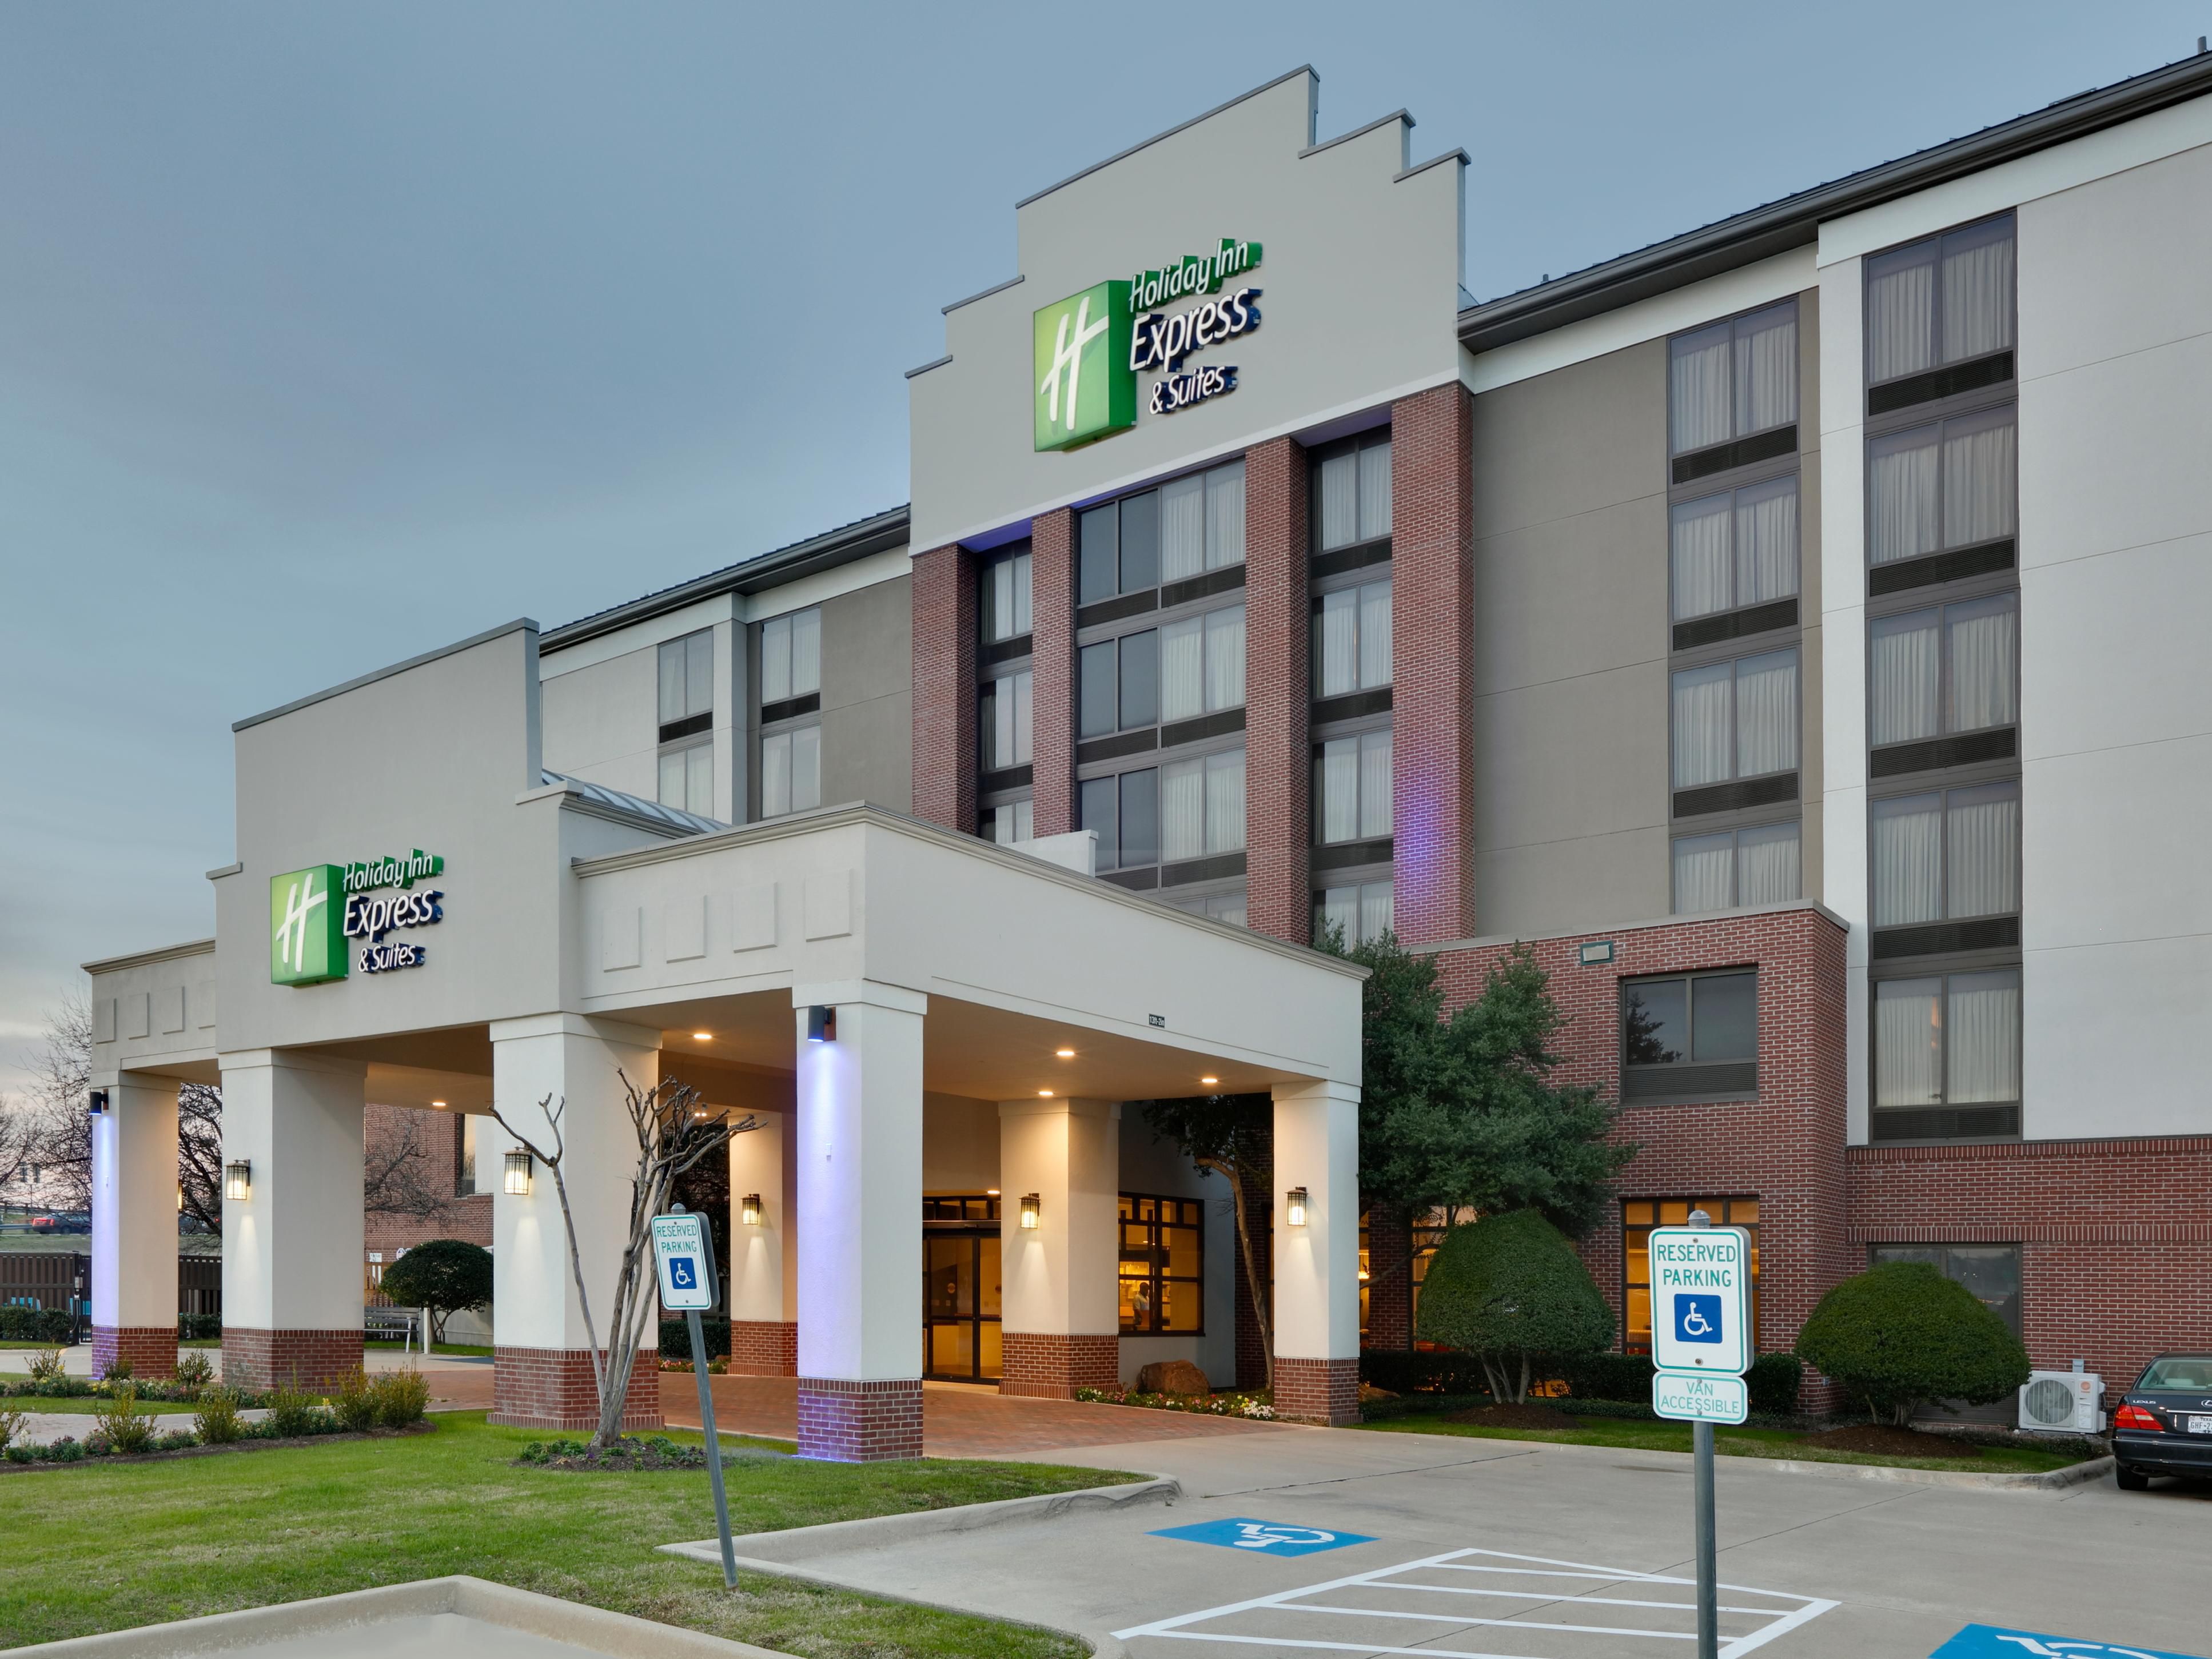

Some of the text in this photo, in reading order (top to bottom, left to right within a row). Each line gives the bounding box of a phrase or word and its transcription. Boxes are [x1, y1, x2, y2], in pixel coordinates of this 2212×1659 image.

[1129, 238, 1248, 313] Holiday Inn
[1129, 288, 1249, 373] Express
[1149, 365, 1225, 415] & Suites
[342, 848, 433, 892] Holiday Inn
[342, 889, 435, 943] Express
[358, 942, 416, 972] & Suites
[656, 1225, 697, 1237] RESERVED
[661, 1241, 697, 1253] PARKING
[1657, 1244, 1736, 1263] RESERVED
[1663, 1269, 1732, 1287] PARKING
[1686, 1381, 1713, 1396] VAN
[1660, 1395, 1740, 1414] ACCESSIBLE
